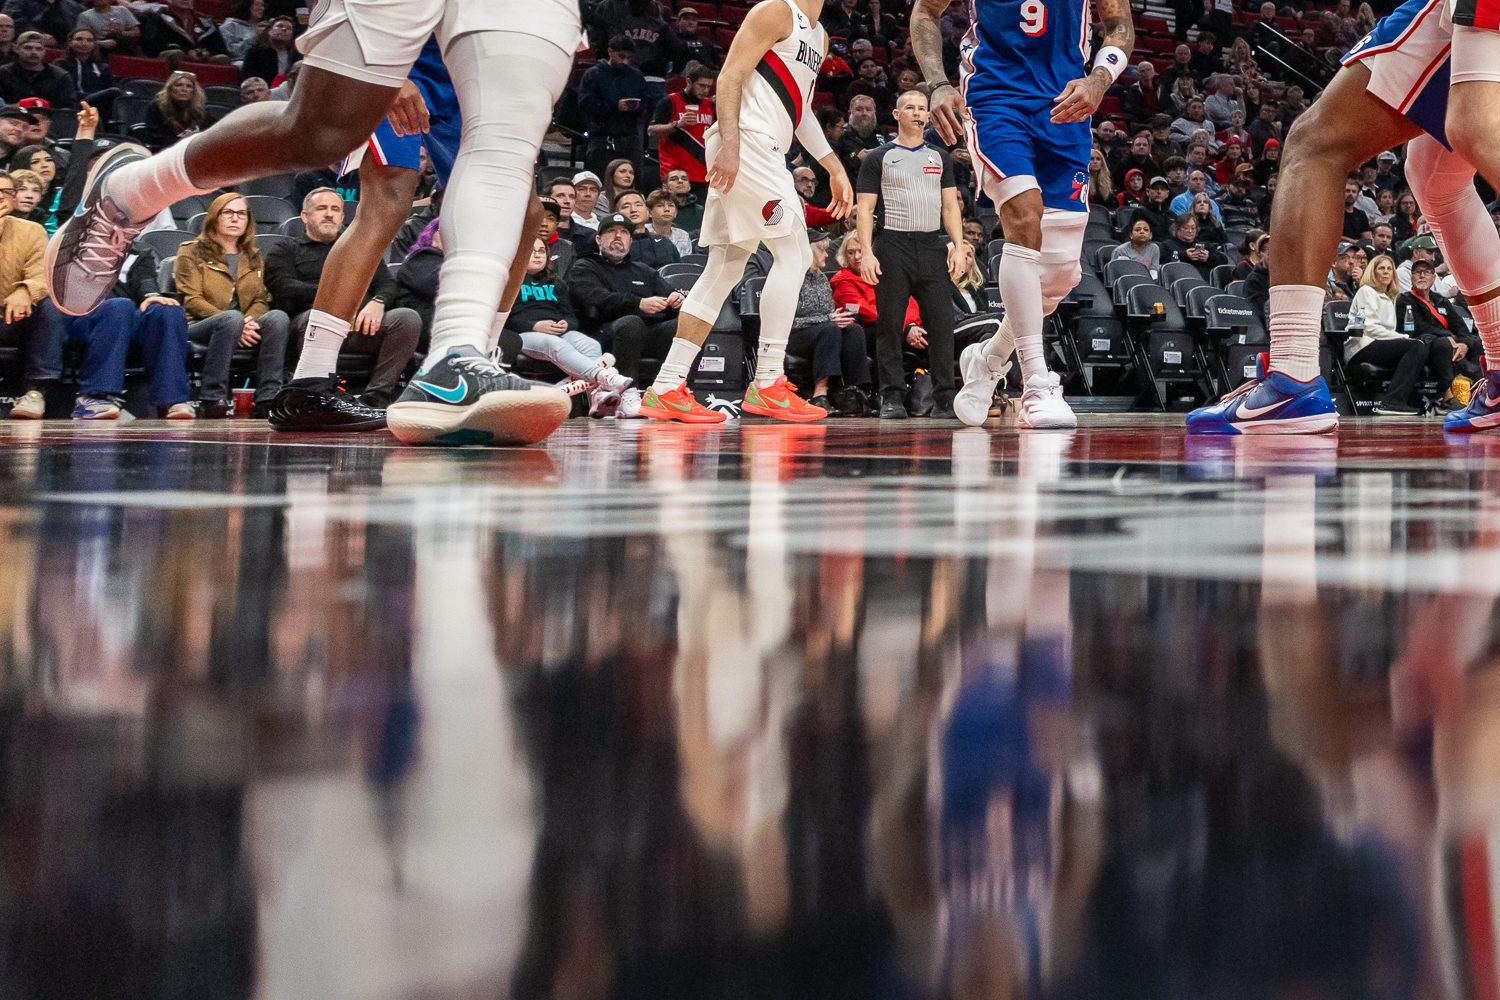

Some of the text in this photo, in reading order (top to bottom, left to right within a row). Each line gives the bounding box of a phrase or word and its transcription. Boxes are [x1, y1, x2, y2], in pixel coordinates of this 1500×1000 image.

[1019, 0, 1047, 37] 9
[1106, 53, 1118, 65] 9
[521, 285, 557, 301] PDX
[1218, 307, 1253, 316] ticketmaster
